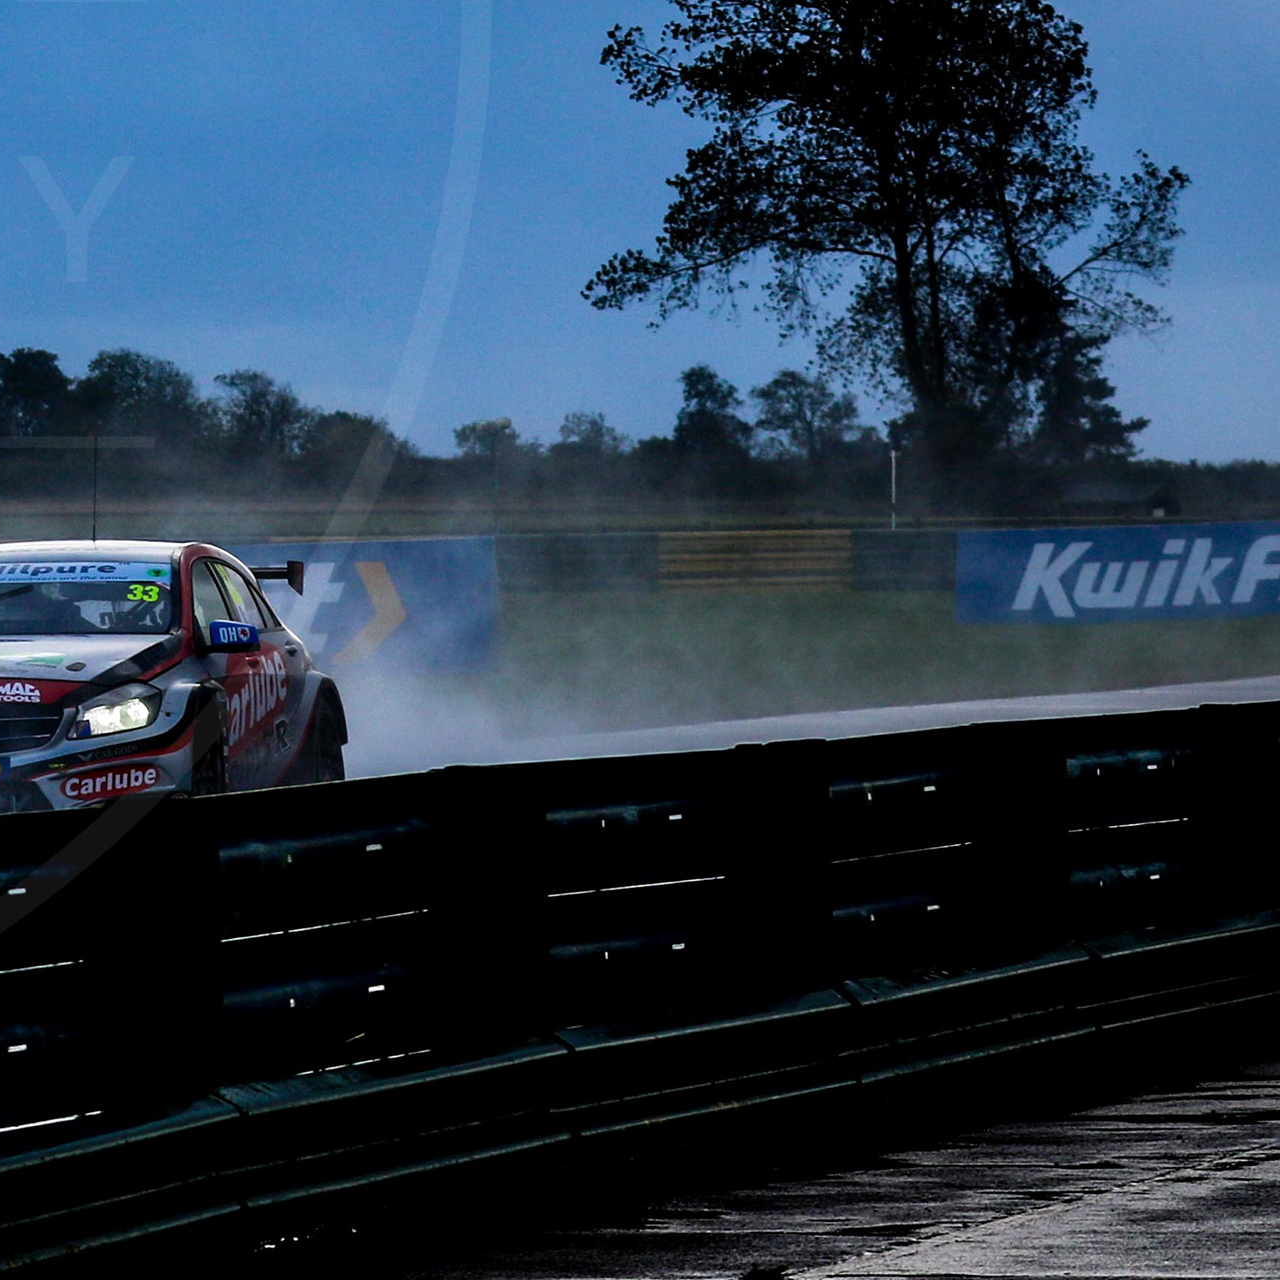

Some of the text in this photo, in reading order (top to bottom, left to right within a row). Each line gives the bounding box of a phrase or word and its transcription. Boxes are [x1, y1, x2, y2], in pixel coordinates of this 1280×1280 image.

[127, 585, 159, 602] 33
[1011, 534, 1280, 618] KwikF
[227, 651, 288, 745] arlube
[65, 769, 157, 797] Carlube
